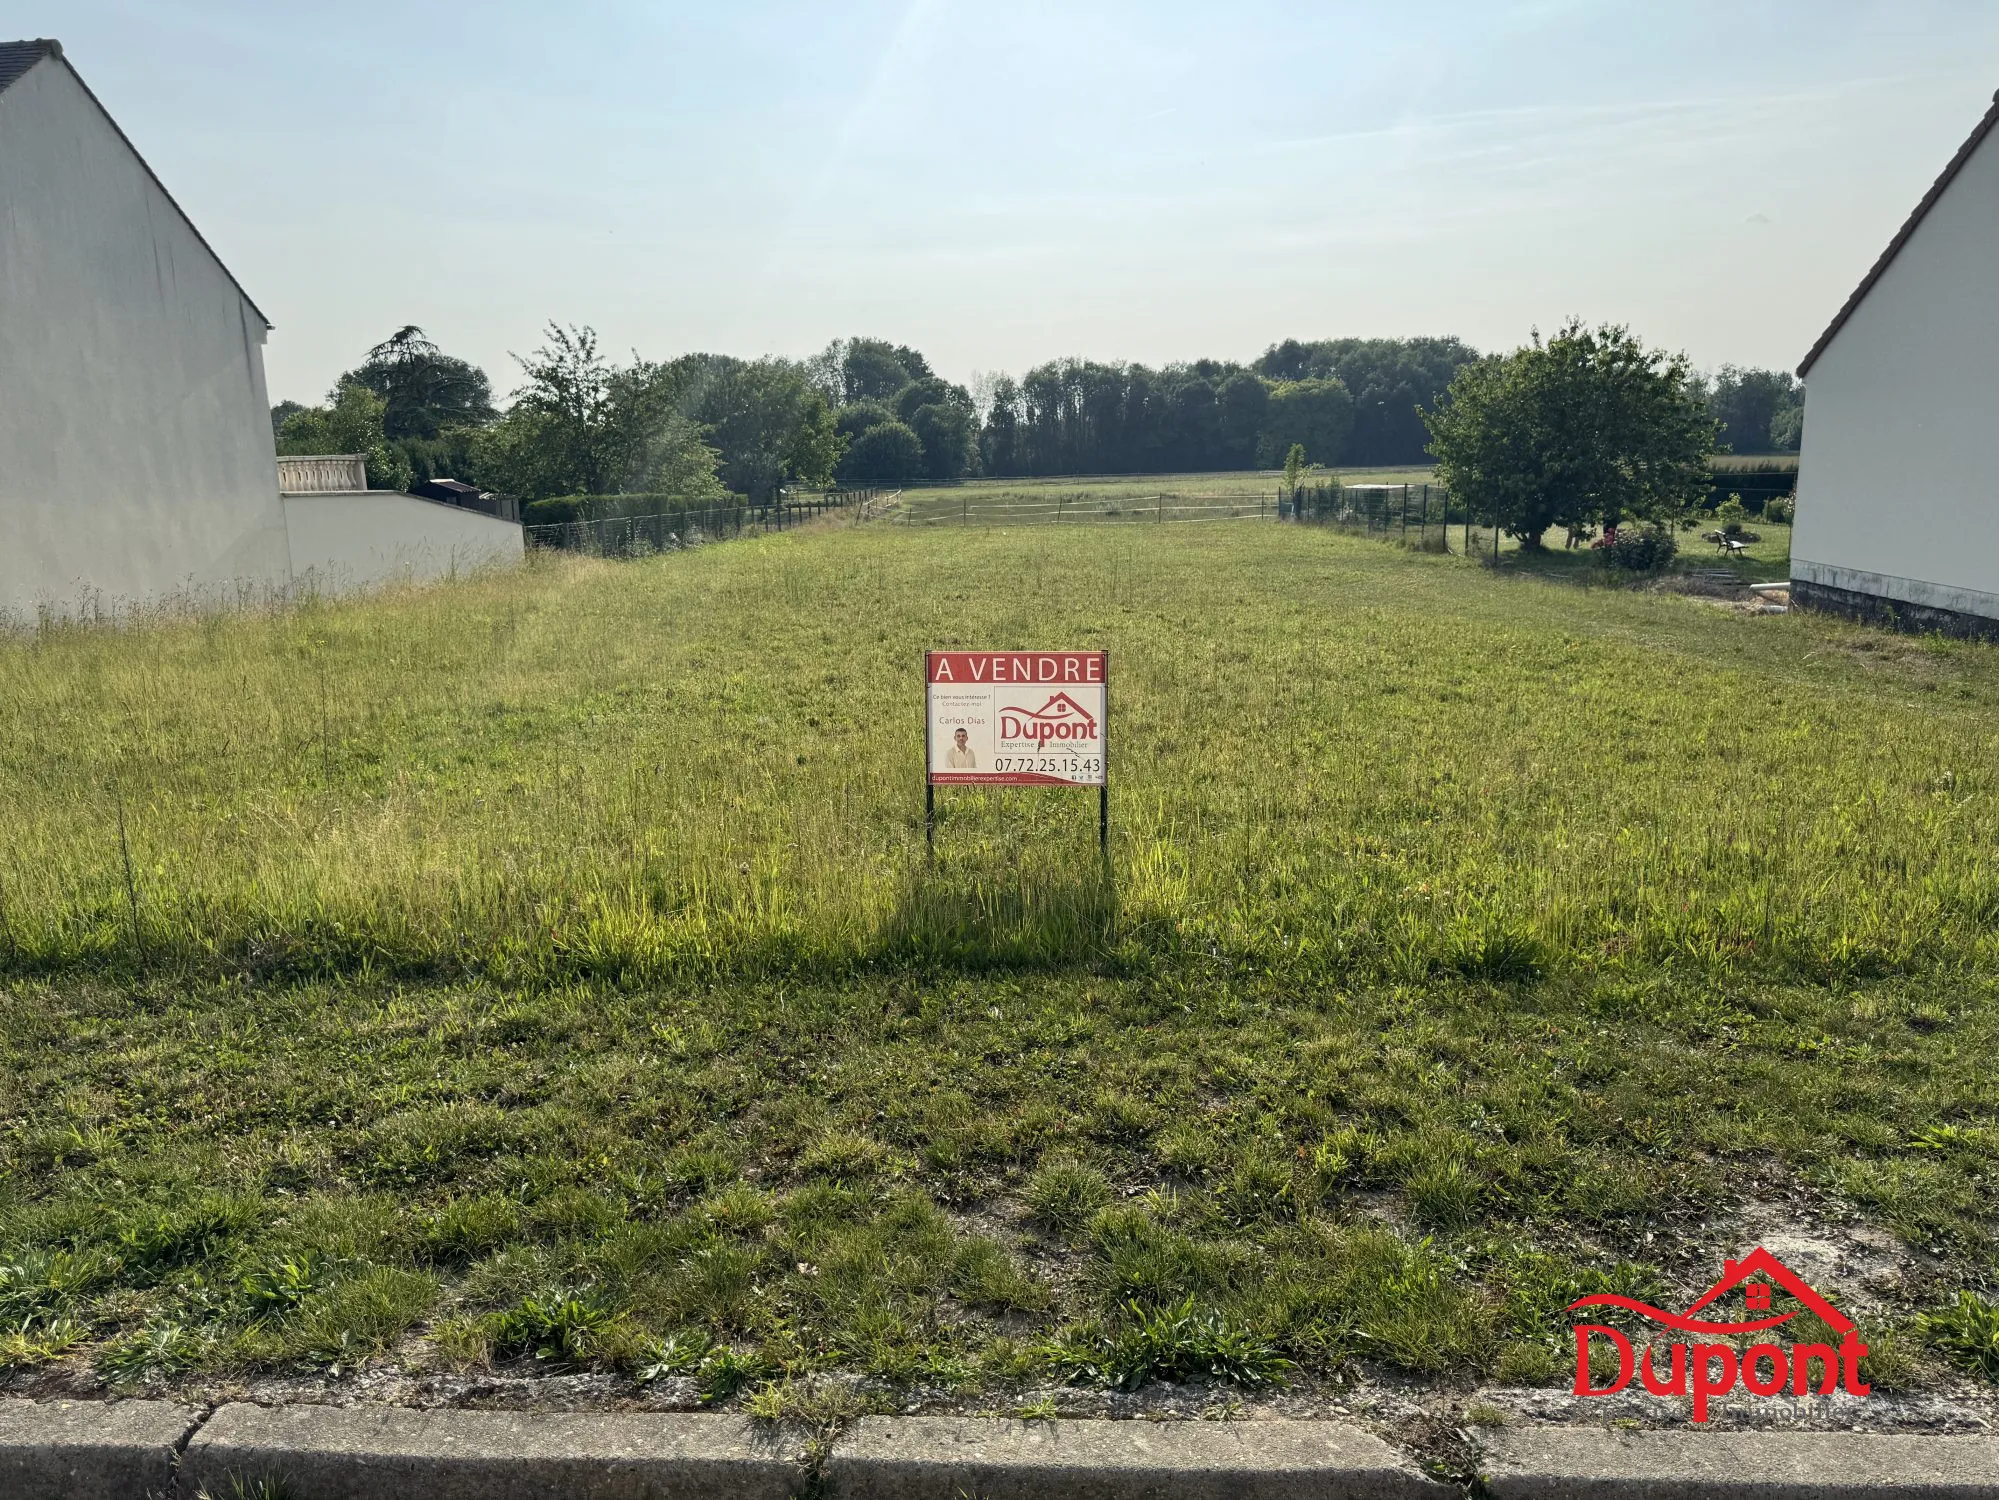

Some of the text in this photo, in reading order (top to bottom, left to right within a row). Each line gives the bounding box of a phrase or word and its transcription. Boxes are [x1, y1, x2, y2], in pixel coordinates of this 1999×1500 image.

[935, 657, 1101, 681] A VENDRE
[1000, 716, 1097, 747] Dupont
[1001, 740, 1088, 749] Expertise Immobilier
[995, 758, 1100, 772] 07.72.25.15.43
